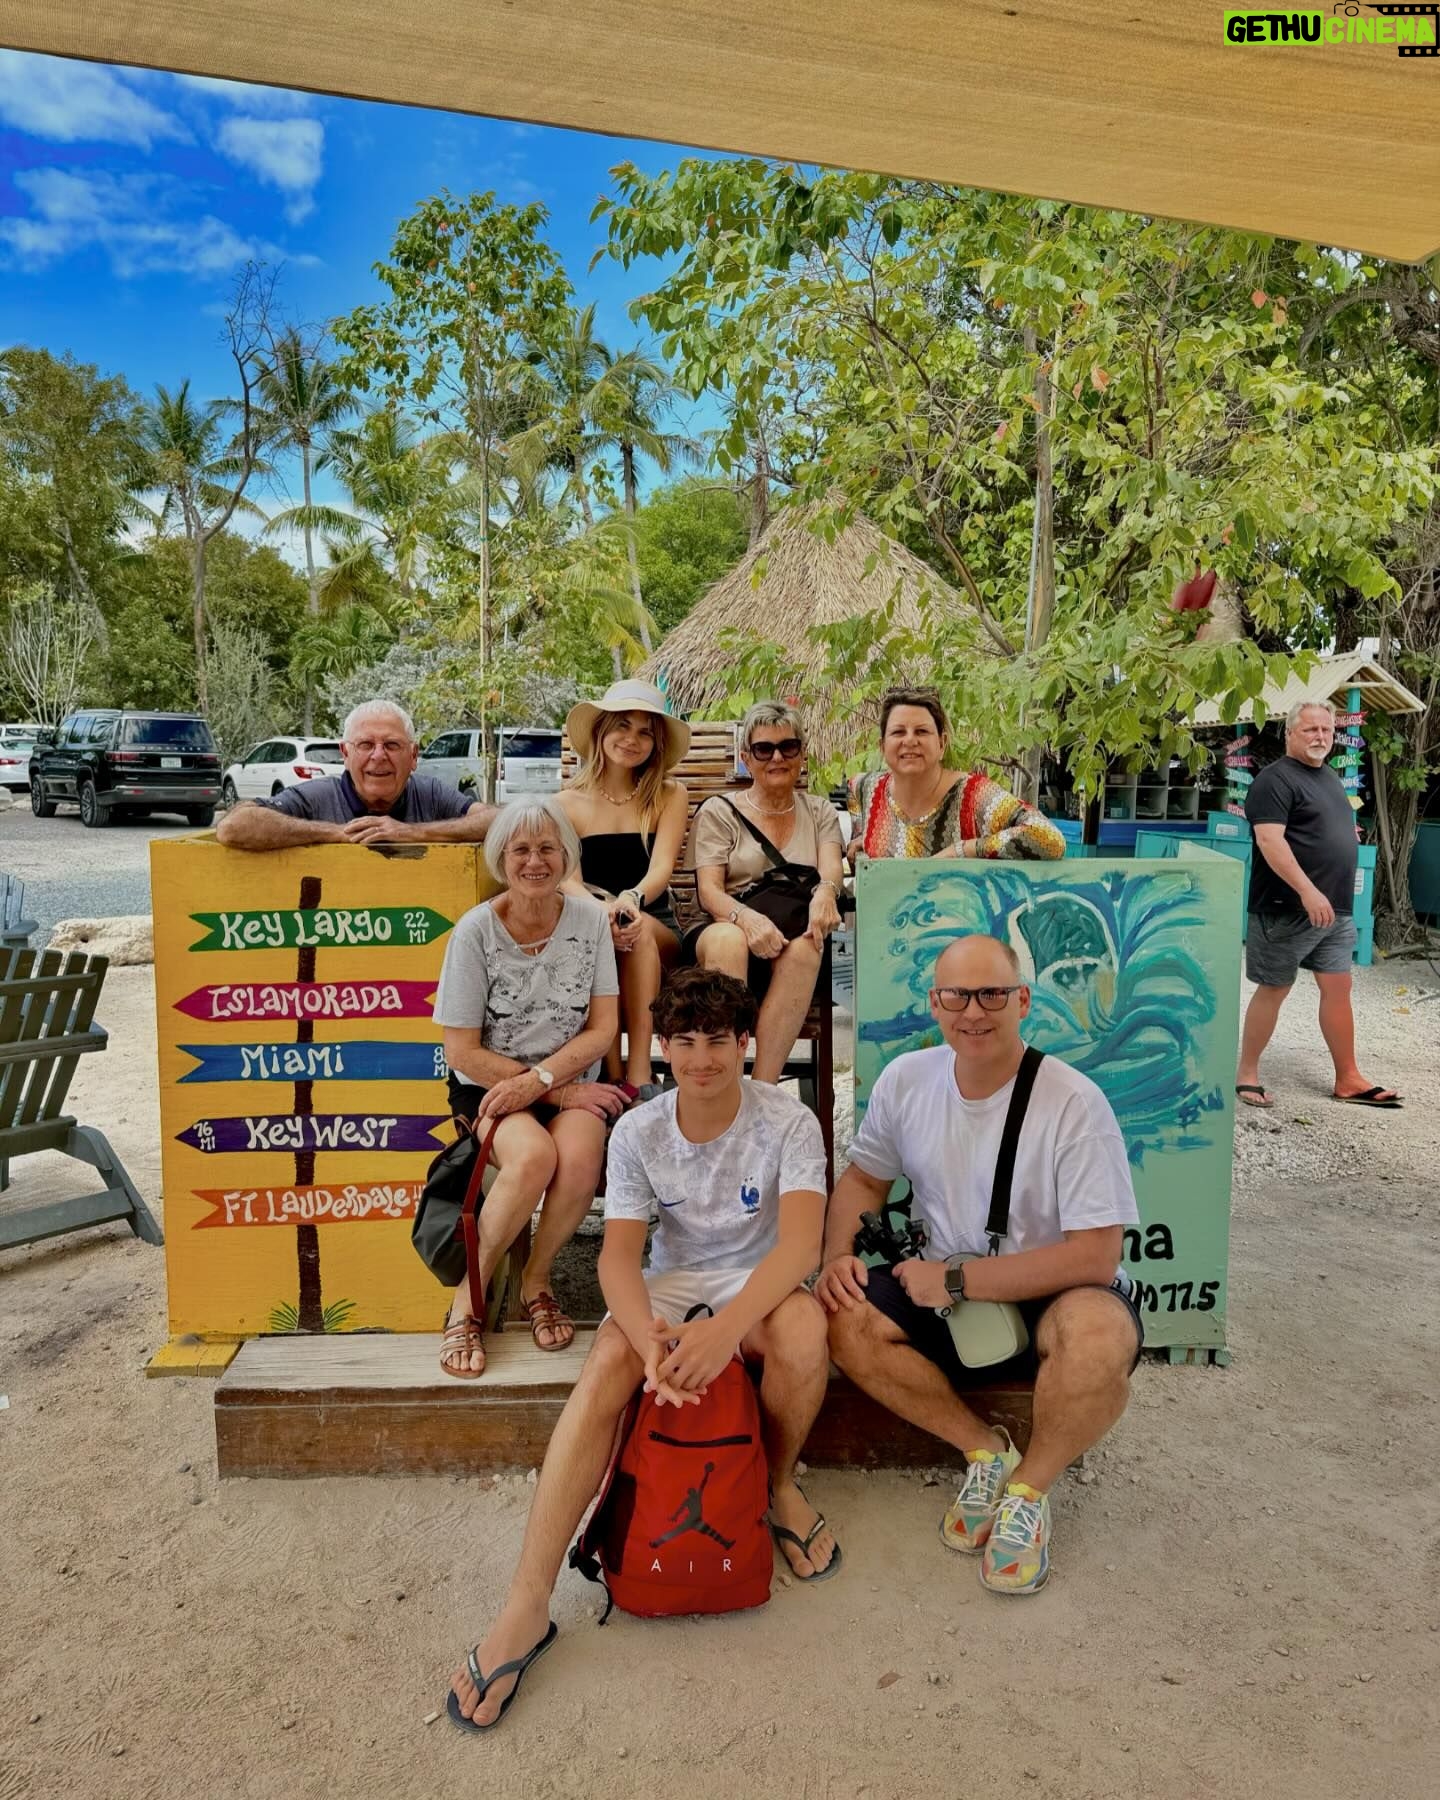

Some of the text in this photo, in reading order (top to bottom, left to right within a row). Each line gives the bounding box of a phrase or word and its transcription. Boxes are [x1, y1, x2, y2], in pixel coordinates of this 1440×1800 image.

[1338, 754, 1357, 769] CRABS
[404, 911, 430, 929] 22
[409, 930, 427, 944] MI
[433, 1046, 448, 1064] 8
[193, 1121, 213, 1137] 76
[199, 1135, 216, 1150] MI
[223, 1190, 259, 1224] FT.
[651, 1558, 732, 1573] AIR
